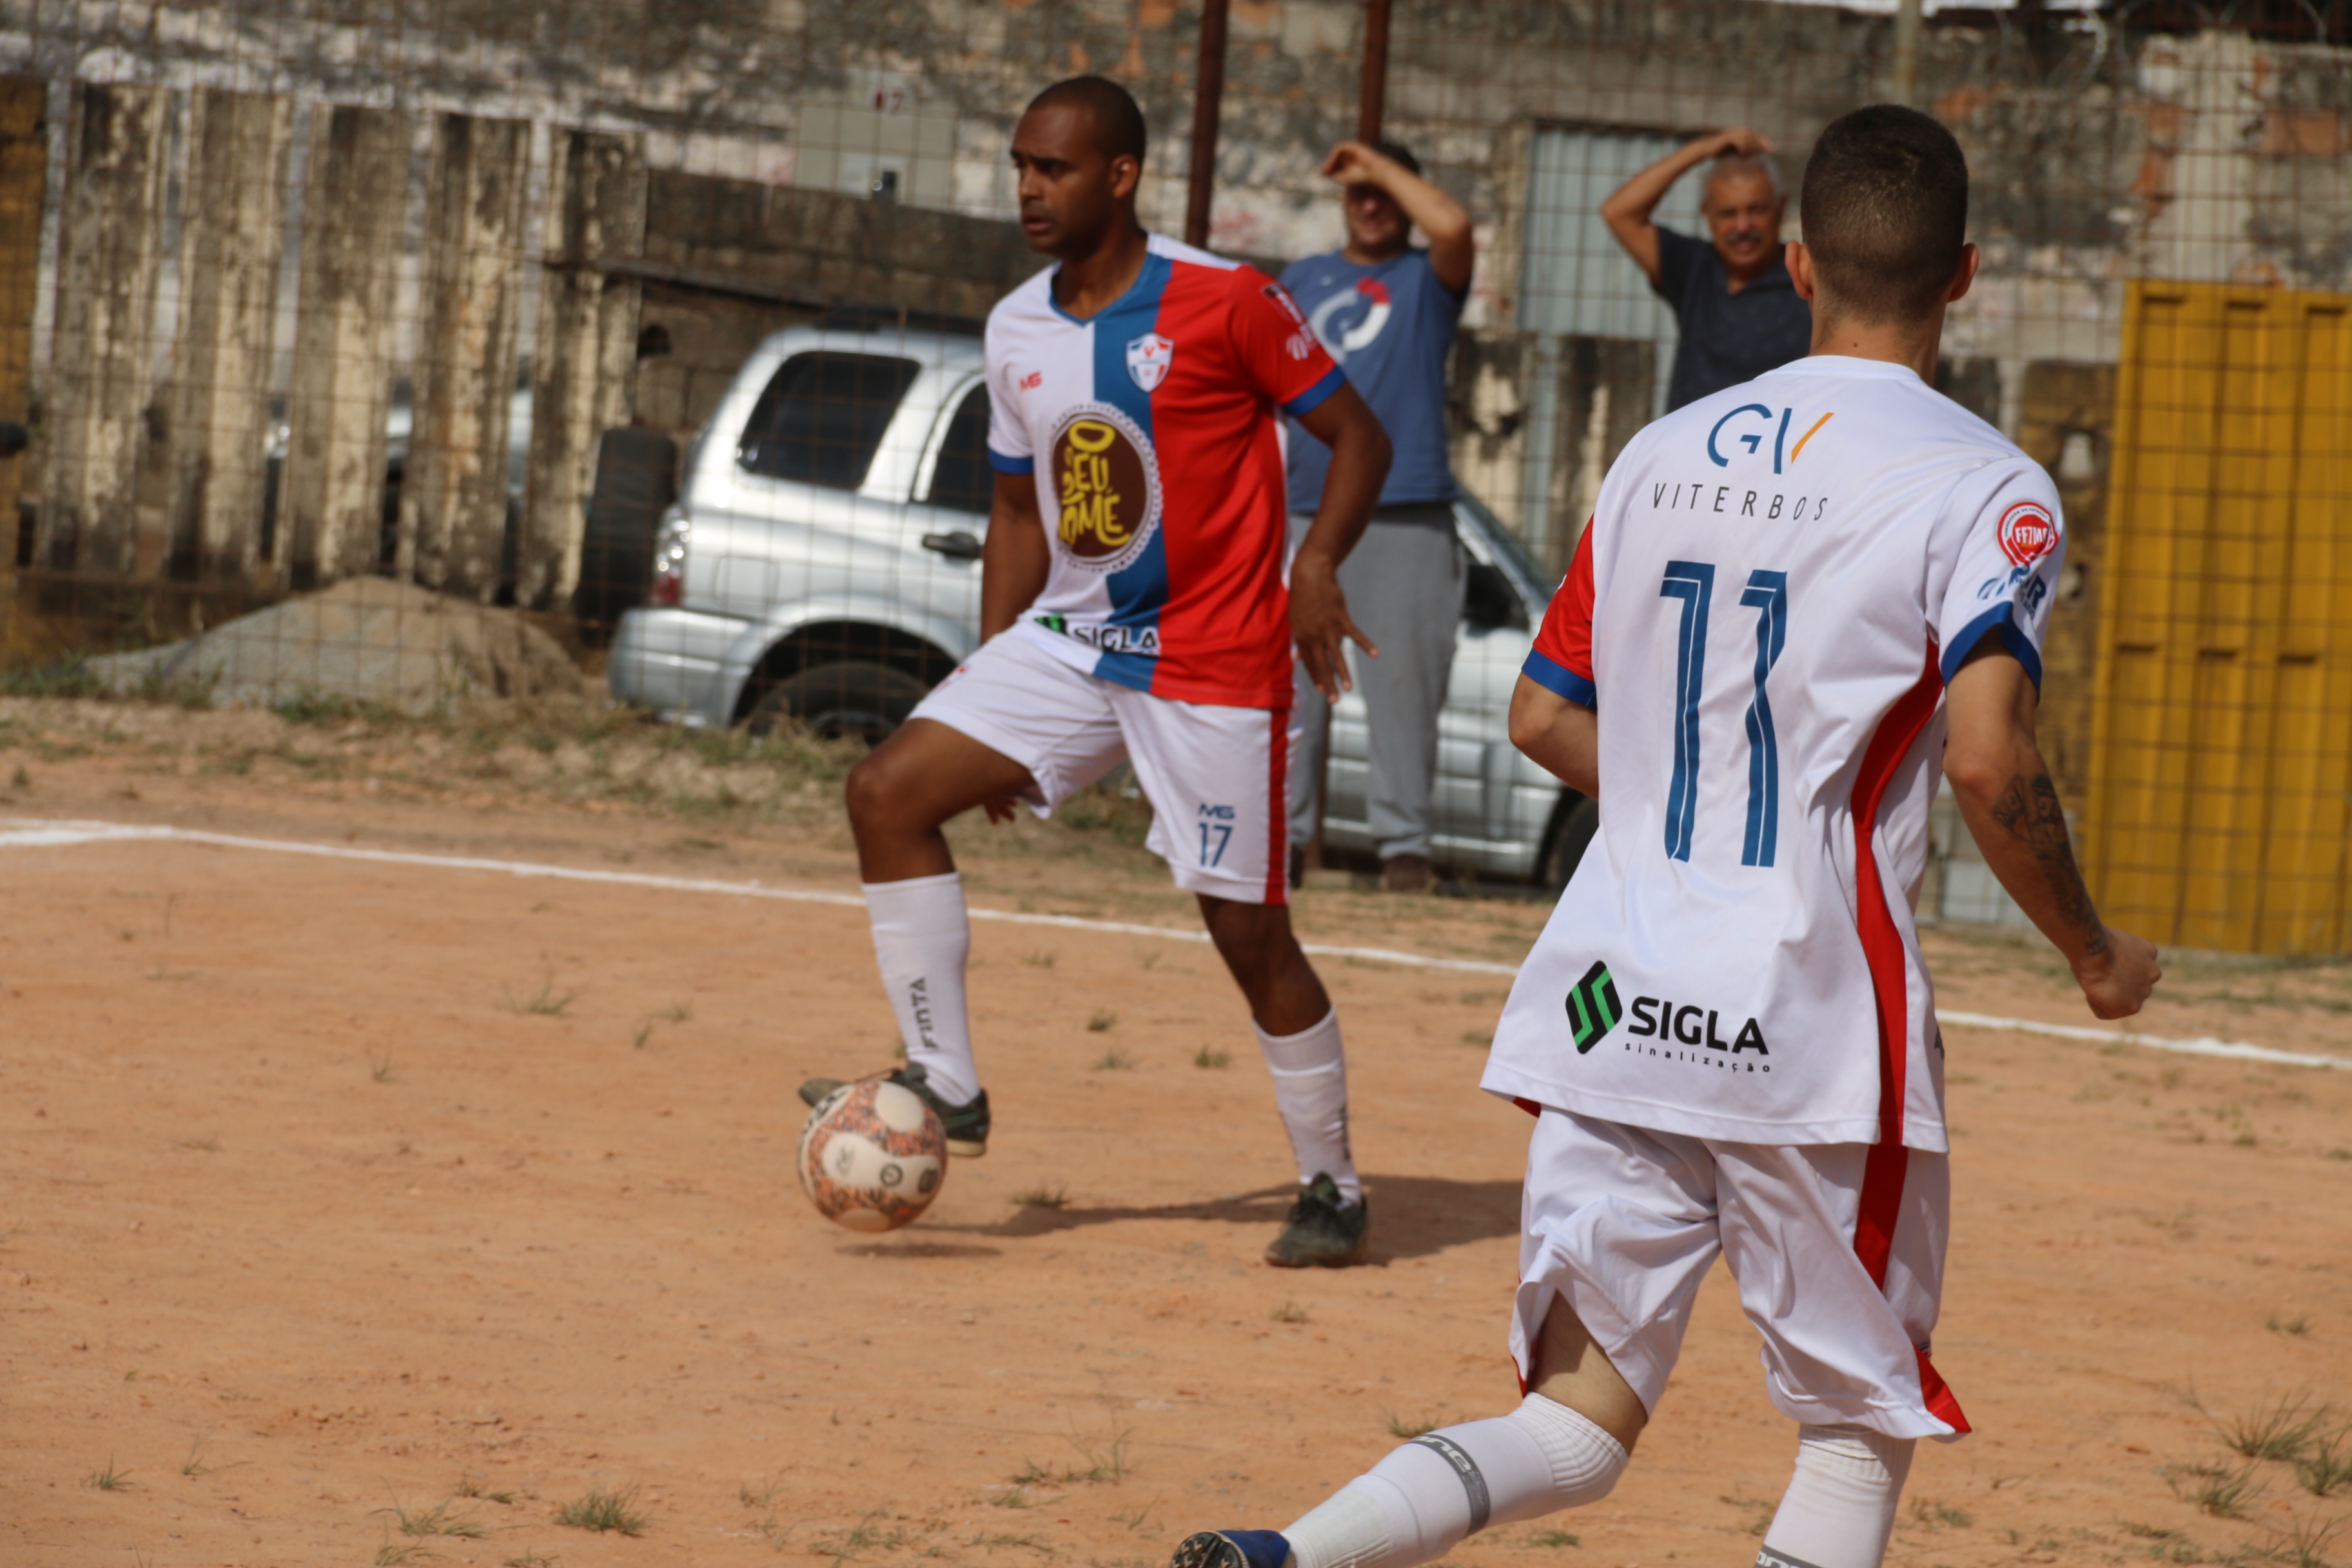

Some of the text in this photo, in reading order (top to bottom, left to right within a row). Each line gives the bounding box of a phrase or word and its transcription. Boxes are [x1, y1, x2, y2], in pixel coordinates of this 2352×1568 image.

[1653, 483, 1828, 521] VITERBOS
[1074, 627, 1157, 651] SIGLA
[1659, 560, 1787, 868] 11
[1199, 822, 1233, 867] 17
[1628, 996, 1769, 1055] SIGLA
[1625, 1042, 1770, 1073] sinalização
